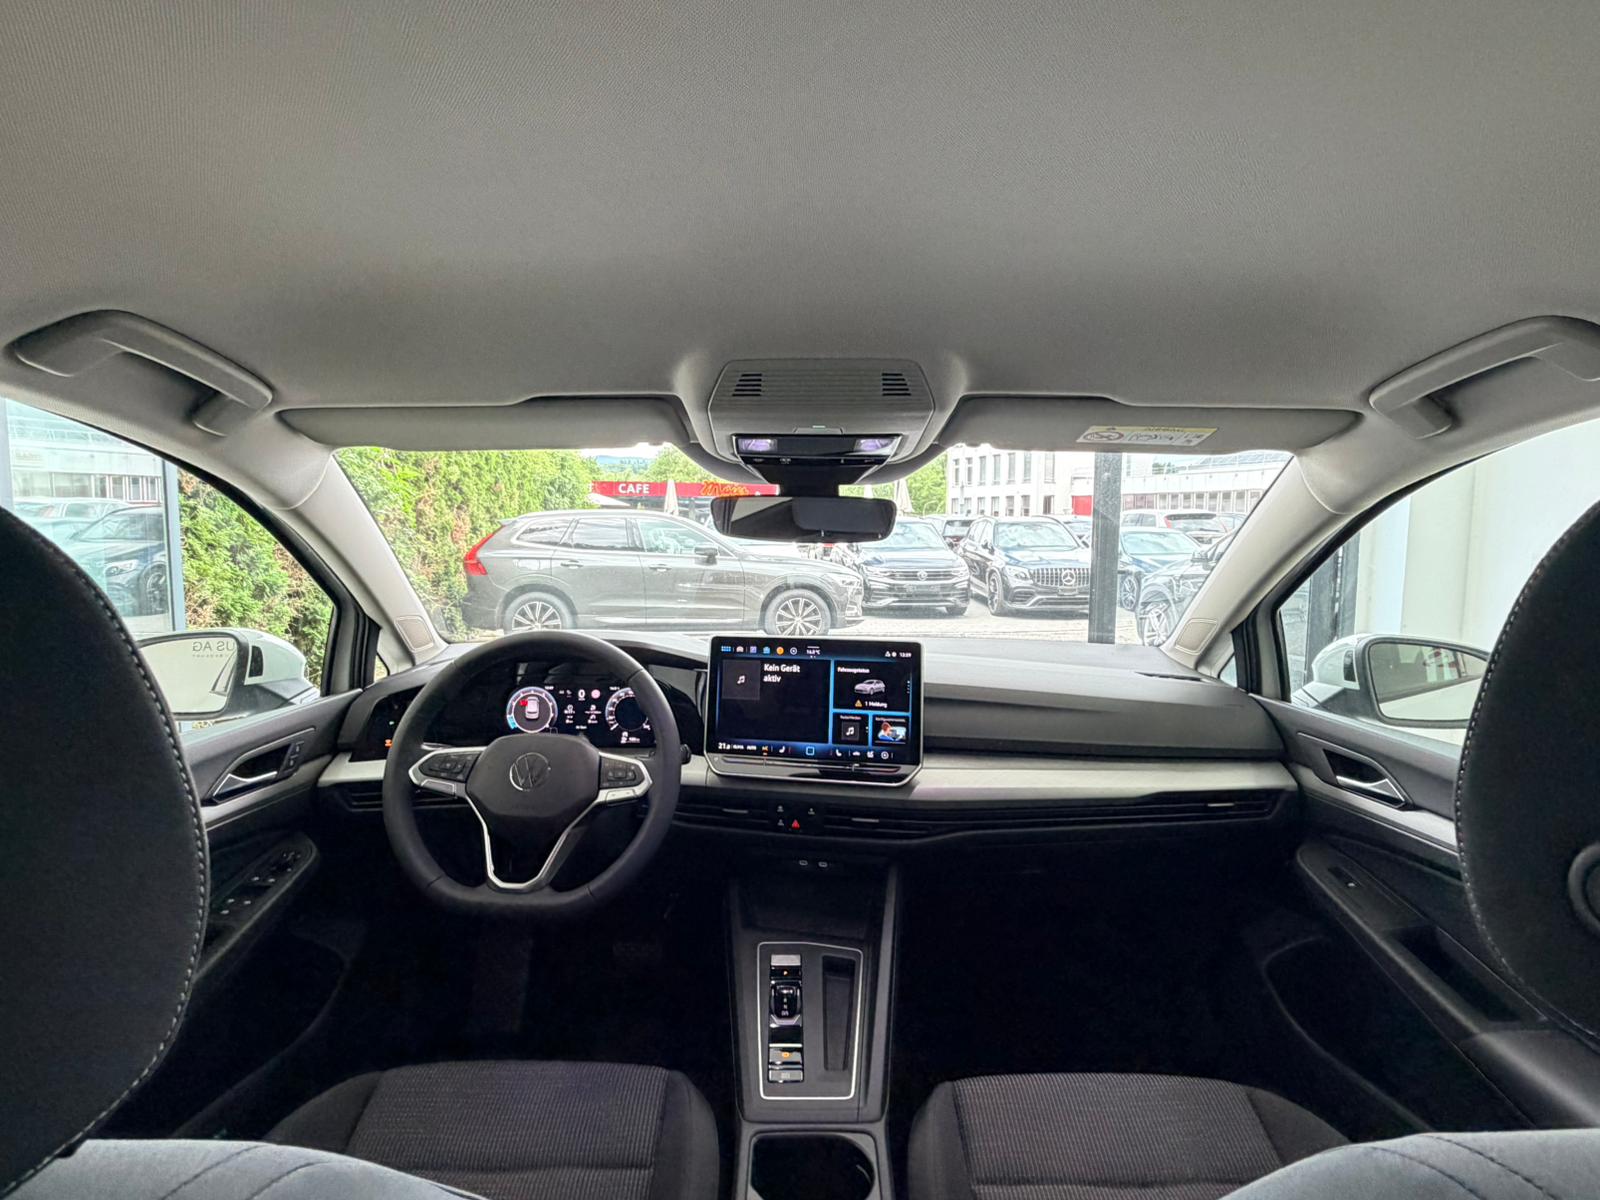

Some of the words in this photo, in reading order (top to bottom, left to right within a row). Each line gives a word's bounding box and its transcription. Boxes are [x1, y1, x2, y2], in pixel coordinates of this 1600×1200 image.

[618, 483, 650, 494] CAFE
[763, 663, 780, 671] Kein
[780, 664, 801, 673] Gerät
[763, 674, 782, 682] aktiv
